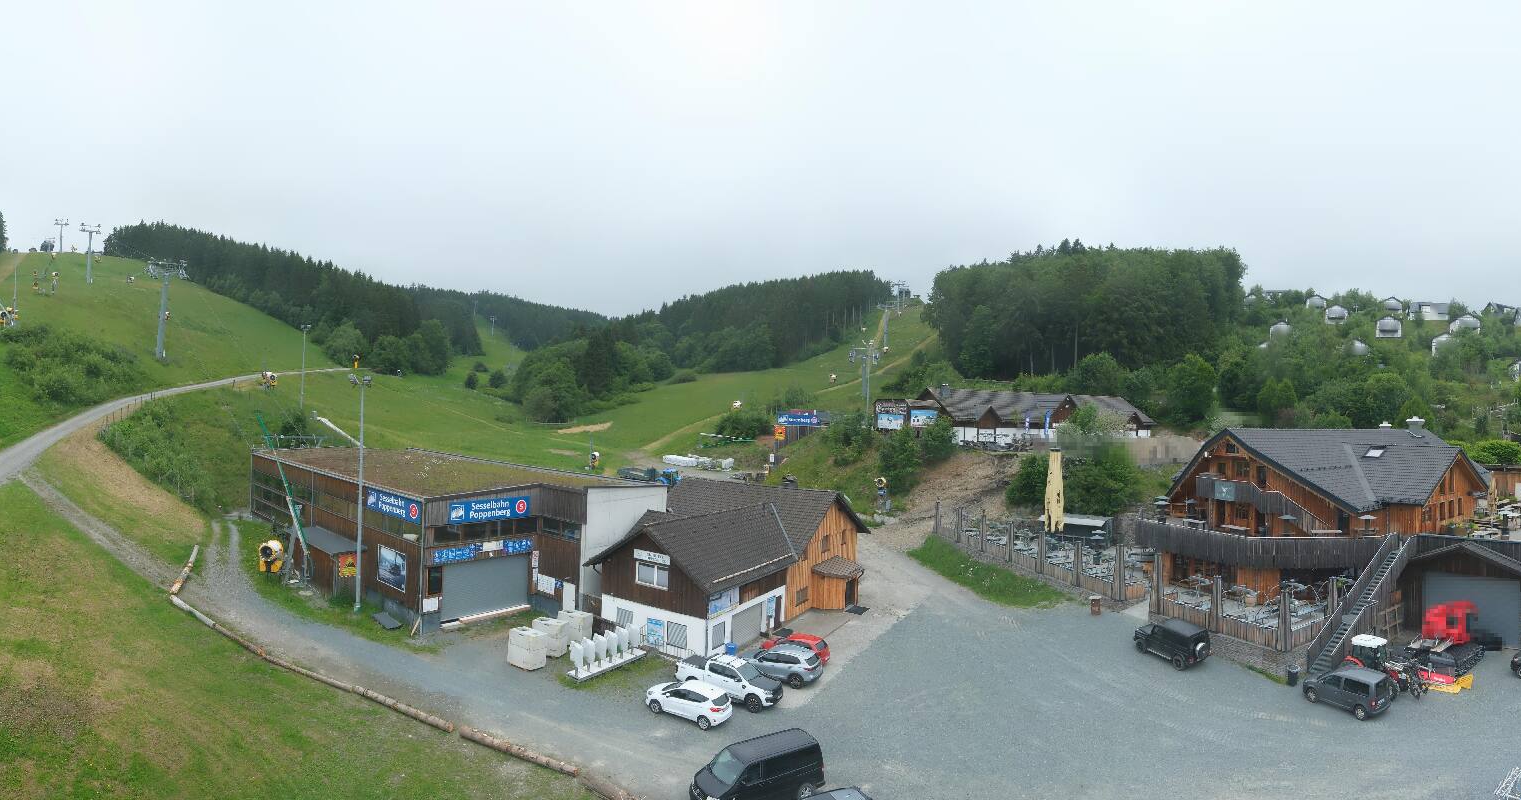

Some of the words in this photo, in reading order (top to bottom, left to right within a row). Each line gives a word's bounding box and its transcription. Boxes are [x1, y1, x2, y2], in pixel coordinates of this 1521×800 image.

[379, 493, 405, 507] Sesselbahn
[471, 500, 510, 511] Sesselbahn
[378, 501, 406, 518] Poppenberg
[469, 509, 511, 520] Poppenberg
